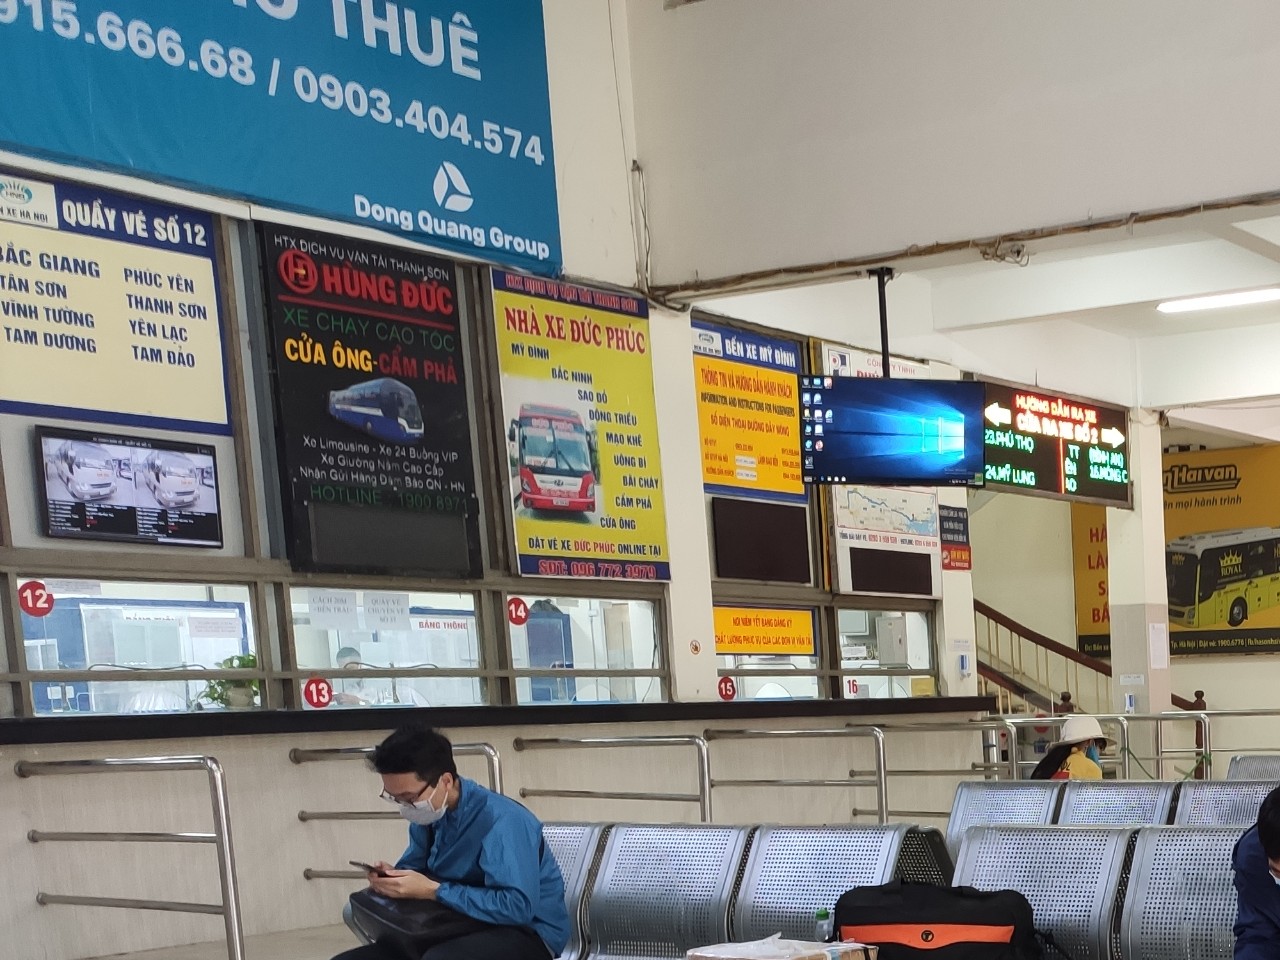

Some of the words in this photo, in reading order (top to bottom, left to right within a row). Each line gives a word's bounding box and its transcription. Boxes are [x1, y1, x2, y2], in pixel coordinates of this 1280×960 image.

[331, 0, 481, 81] THUÊ
[268, 57, 280, 96] /
[293, 66, 545, 166] 0903.404.574
[122, 209, 149, 238] VÉ
[154, 214, 180, 244] SỐ
[183, 221, 207, 246] 12
[354, 194, 413, 231] Dong
[418, 210, 486, 247] Quang
[489, 226, 550, 260] Group
[39, 252, 100, 278] GIANG
[274, 234, 296, 249] HTX
[299, 240, 327, 257] DỊCH
[390, 259, 425, 277] THANH
[0, 274, 30, 294] TÂN
[35, 280, 67, 299] SƠN
[167, 274, 194, 294] YÊN
[322, 261, 397, 305] HÙNG
[401, 275, 454, 315] ĐỨC
[1, 299, 38, 320] VĨNH
[43, 305, 95, 328] TƯỜNG
[126, 293, 174, 316] THANH
[178, 303, 208, 320] SƠN
[4, 326, 38, 345] TAM
[129, 318, 157, 338] YÊN
[161, 326, 188, 345] LẠC
[283, 307, 309, 328] XE
[375, 323, 414, 345] CAO
[504, 304, 541, 337] NHÀ
[544, 314, 567, 341] XE
[570, 315, 602, 347] ĐỨC
[605, 323, 646, 354] PHÚC
[131, 344, 163, 363] TAM
[167, 345, 196, 368] ĐẢO
[284, 332, 327, 366] CỬA
[724, 335, 745, 358] BẾN
[745, 342, 758, 360] XE
[759, 344, 773, 363] MỸ
[774, 346, 796, 368] ĐÌNH
[571, 370, 593, 385] NINH
[577, 389, 594, 402] SAO
[1071, 405, 1085, 421] RA
[605, 431, 625, 448] MẠO
[1042, 417, 1059, 437] RA
[1090, 428, 1098, 444] 2
[303, 435, 317, 449] Xe
[320, 437, 370, 454] Limousine
[379, 443, 392, 457] Xe
[395, 446, 406, 458] 24
[442, 451, 459, 463] VIP
[1015, 434, 1035, 454] THỌ
[321, 452, 335, 465] Xe
[402, 462, 422, 475] Cao
[613, 454, 637, 468] UÔNG
[426, 479, 442, 491] QN
[450, 482, 466, 493] HN
[1012, 468, 1036, 486] LUNG
[310, 484, 383, 506] HOTLINE
[1175, 497, 1192, 511] mọi
[1194, 496, 1218, 508] hành
[1220, 494, 1242, 506] trình
[619, 516, 637, 530] ÔNG
[560, 538, 572, 551] XE
[573, 538, 591, 553] ĐỨC
[617, 543, 647, 556] ONLINE
[571, 561, 596, 577] 096
[598, 562, 623, 578] 772
[1221, 563, 1242, 576] ROYAL
[22, 588, 49, 609] 12
[509, 603, 526, 620] 14
[308, 683, 329, 704] 13
[720, 681, 733, 696] 15
[846, 678, 858, 695] 16
